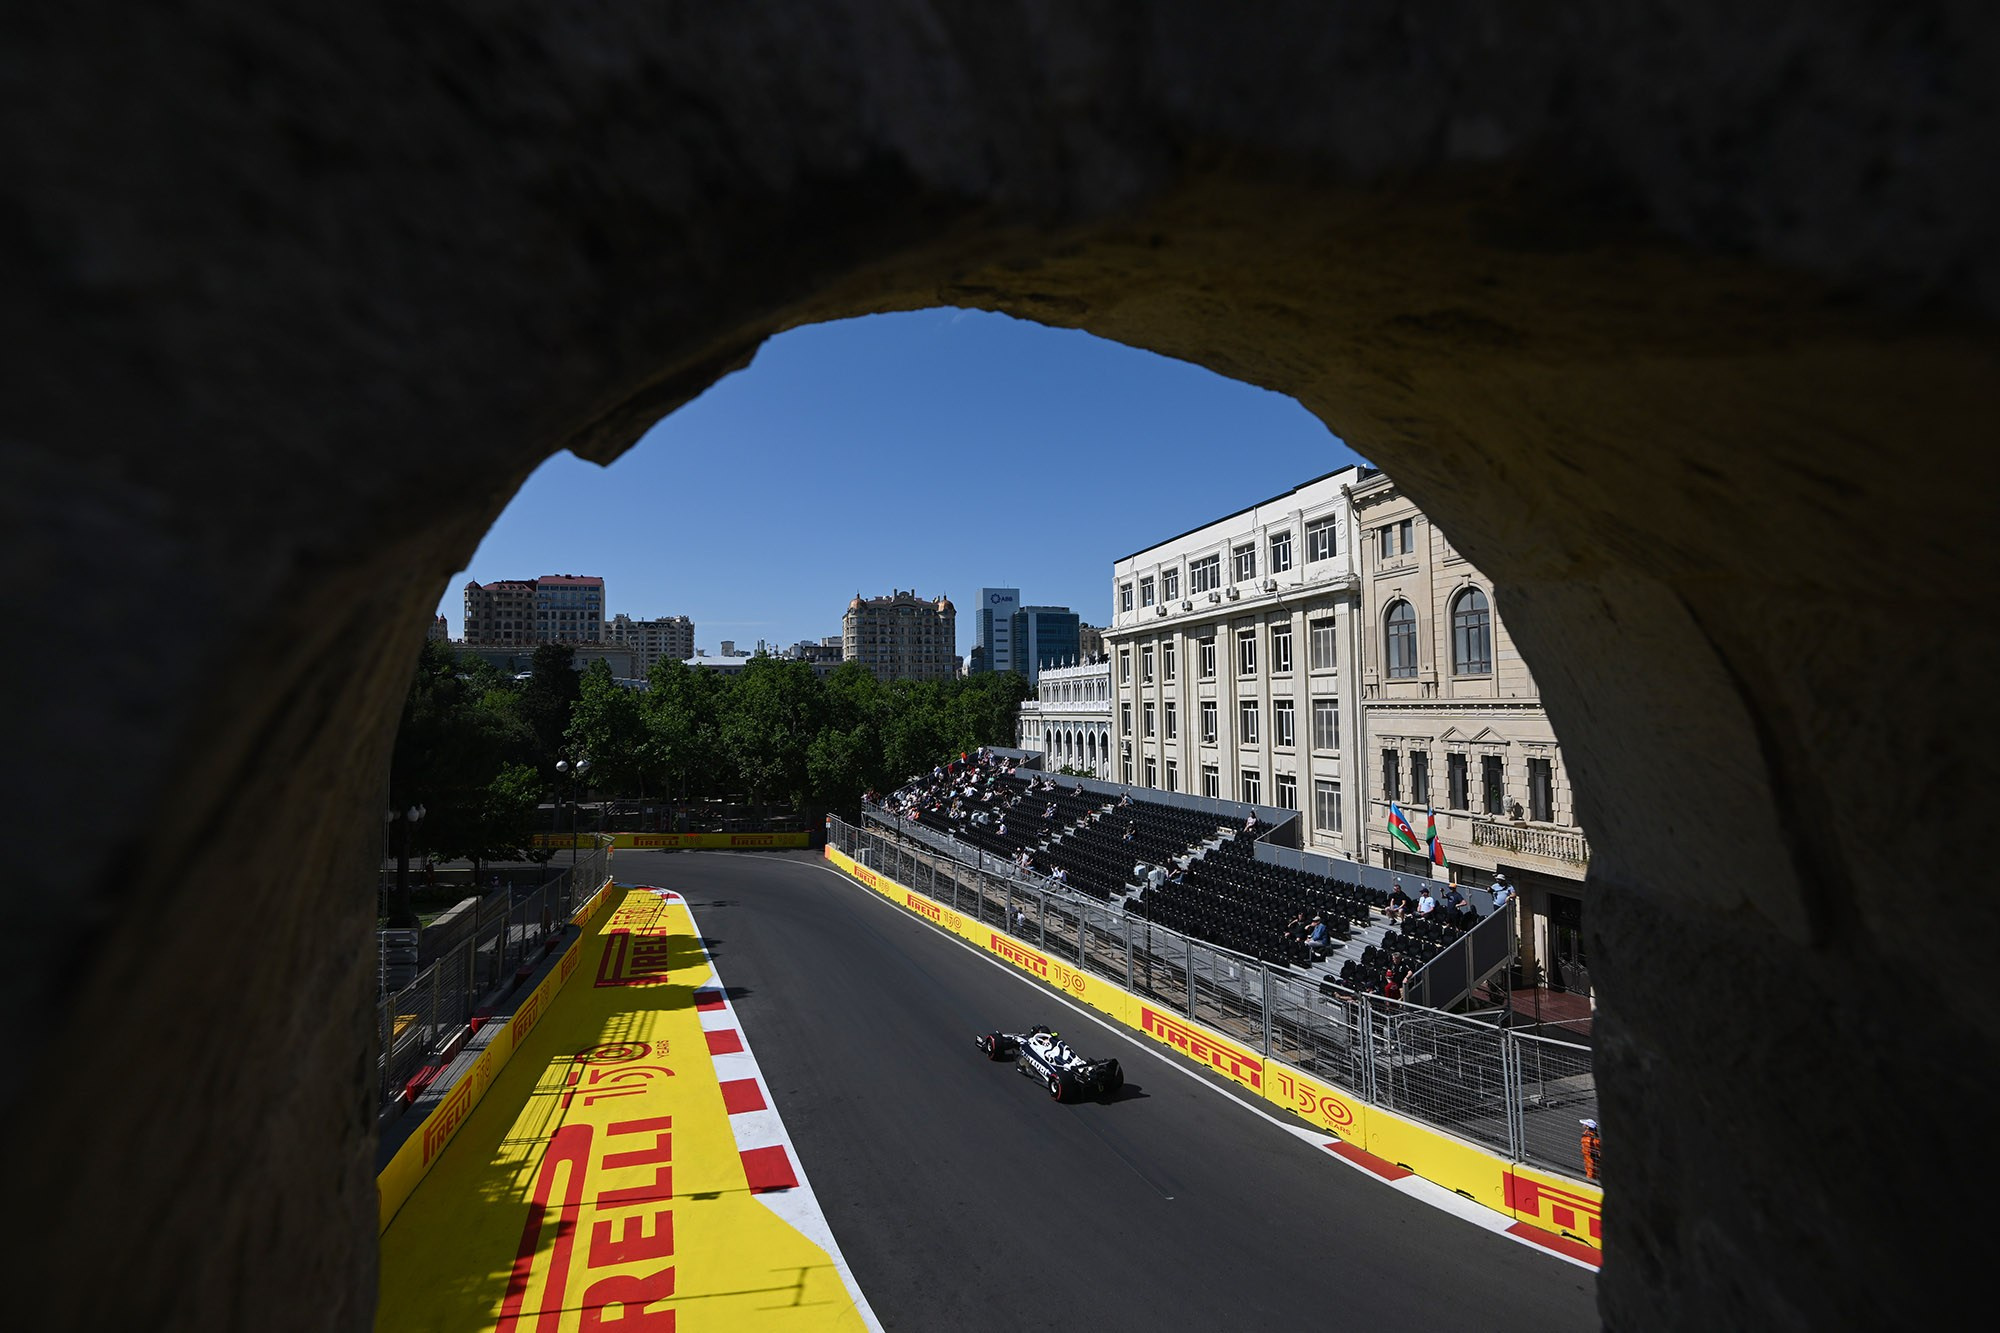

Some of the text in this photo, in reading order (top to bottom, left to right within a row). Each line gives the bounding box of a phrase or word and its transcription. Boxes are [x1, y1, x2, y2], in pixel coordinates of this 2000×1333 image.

[633, 836, 679, 846] PIRELLI
[731, 836, 773, 845] PIRELLI
[854, 865, 876, 887] PIRELLI
[907, 893, 962, 929] PIRELLI 150
[991, 934, 1086, 991] PIRELLI 150
[512, 993, 539, 1050] PIRELLI
[561, 1042, 676, 1109] 150
[1142, 1007, 1353, 1126] PIRELLI 150
[423, 1075, 473, 1168] PIRELLI
[1323, 1117, 1351, 1136] YEARS
